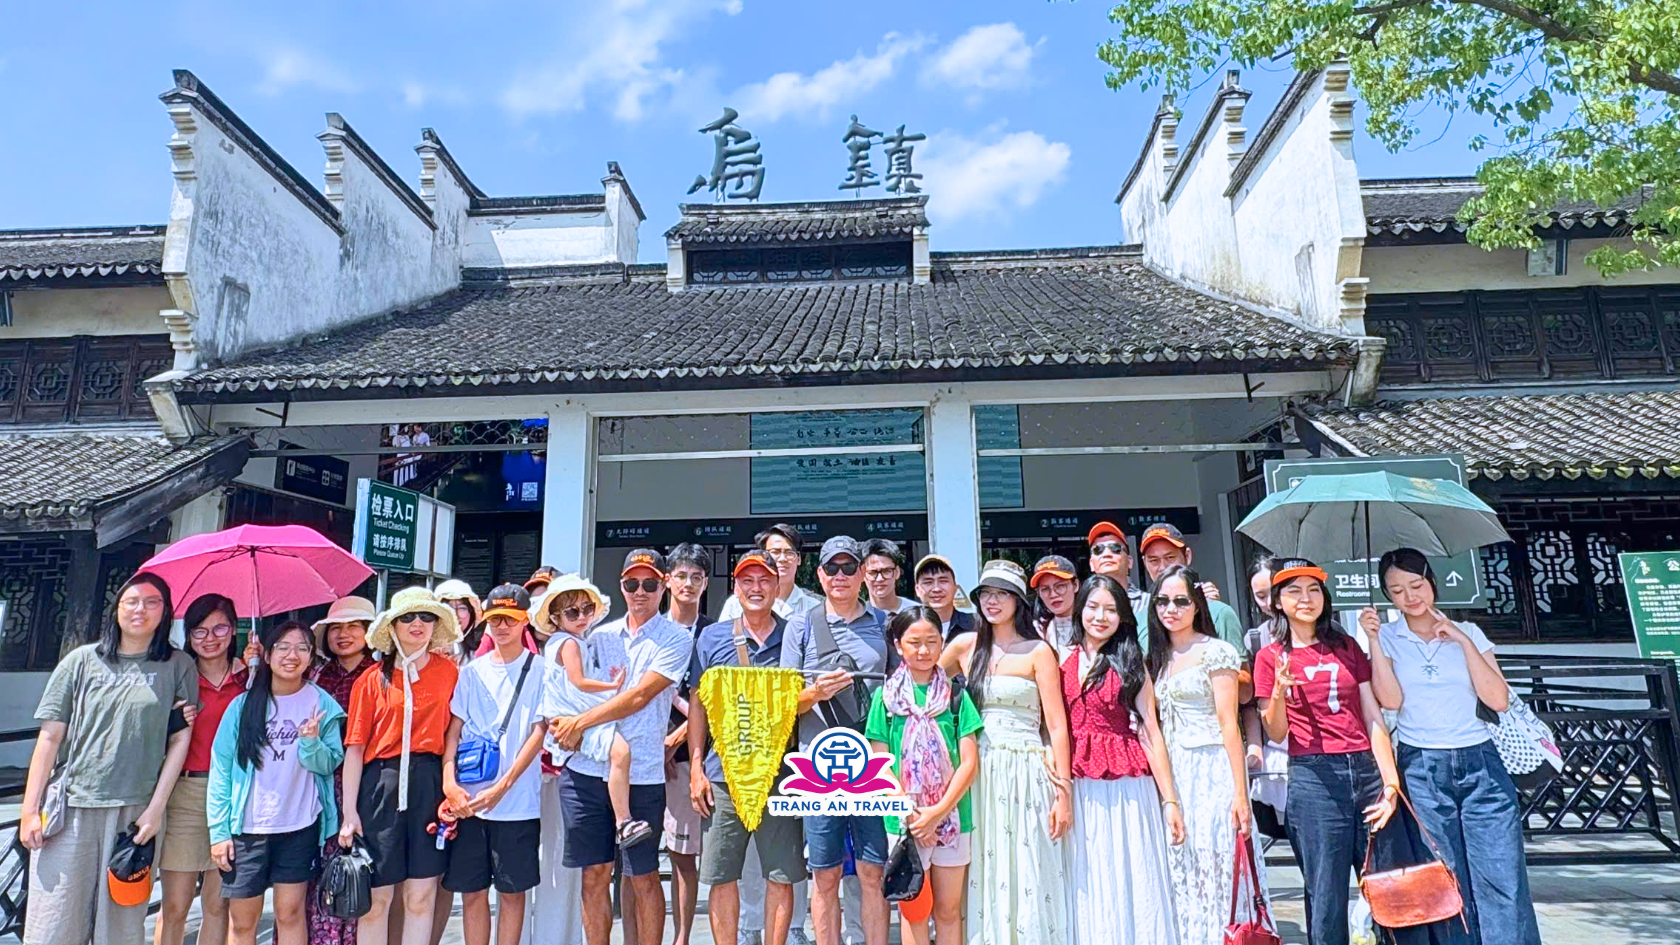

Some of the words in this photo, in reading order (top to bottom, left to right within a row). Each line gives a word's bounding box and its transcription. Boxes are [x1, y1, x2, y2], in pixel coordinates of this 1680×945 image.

[371, 492, 414, 522] 检票入口
[373, 517, 388, 528] Ticket
[388, 520, 410, 534] Checking
[372, 533, 407, 552] 请按序排队
[373, 548, 387, 557] Please
[387, 550, 399, 559] Queue
[399, 552, 405, 560] Up
[1335, 573, 1380, 589] 卫生间
[1303, 662, 1340, 714] 7
[737, 693, 752, 756] GROUP
[272, 750, 286, 761] M
